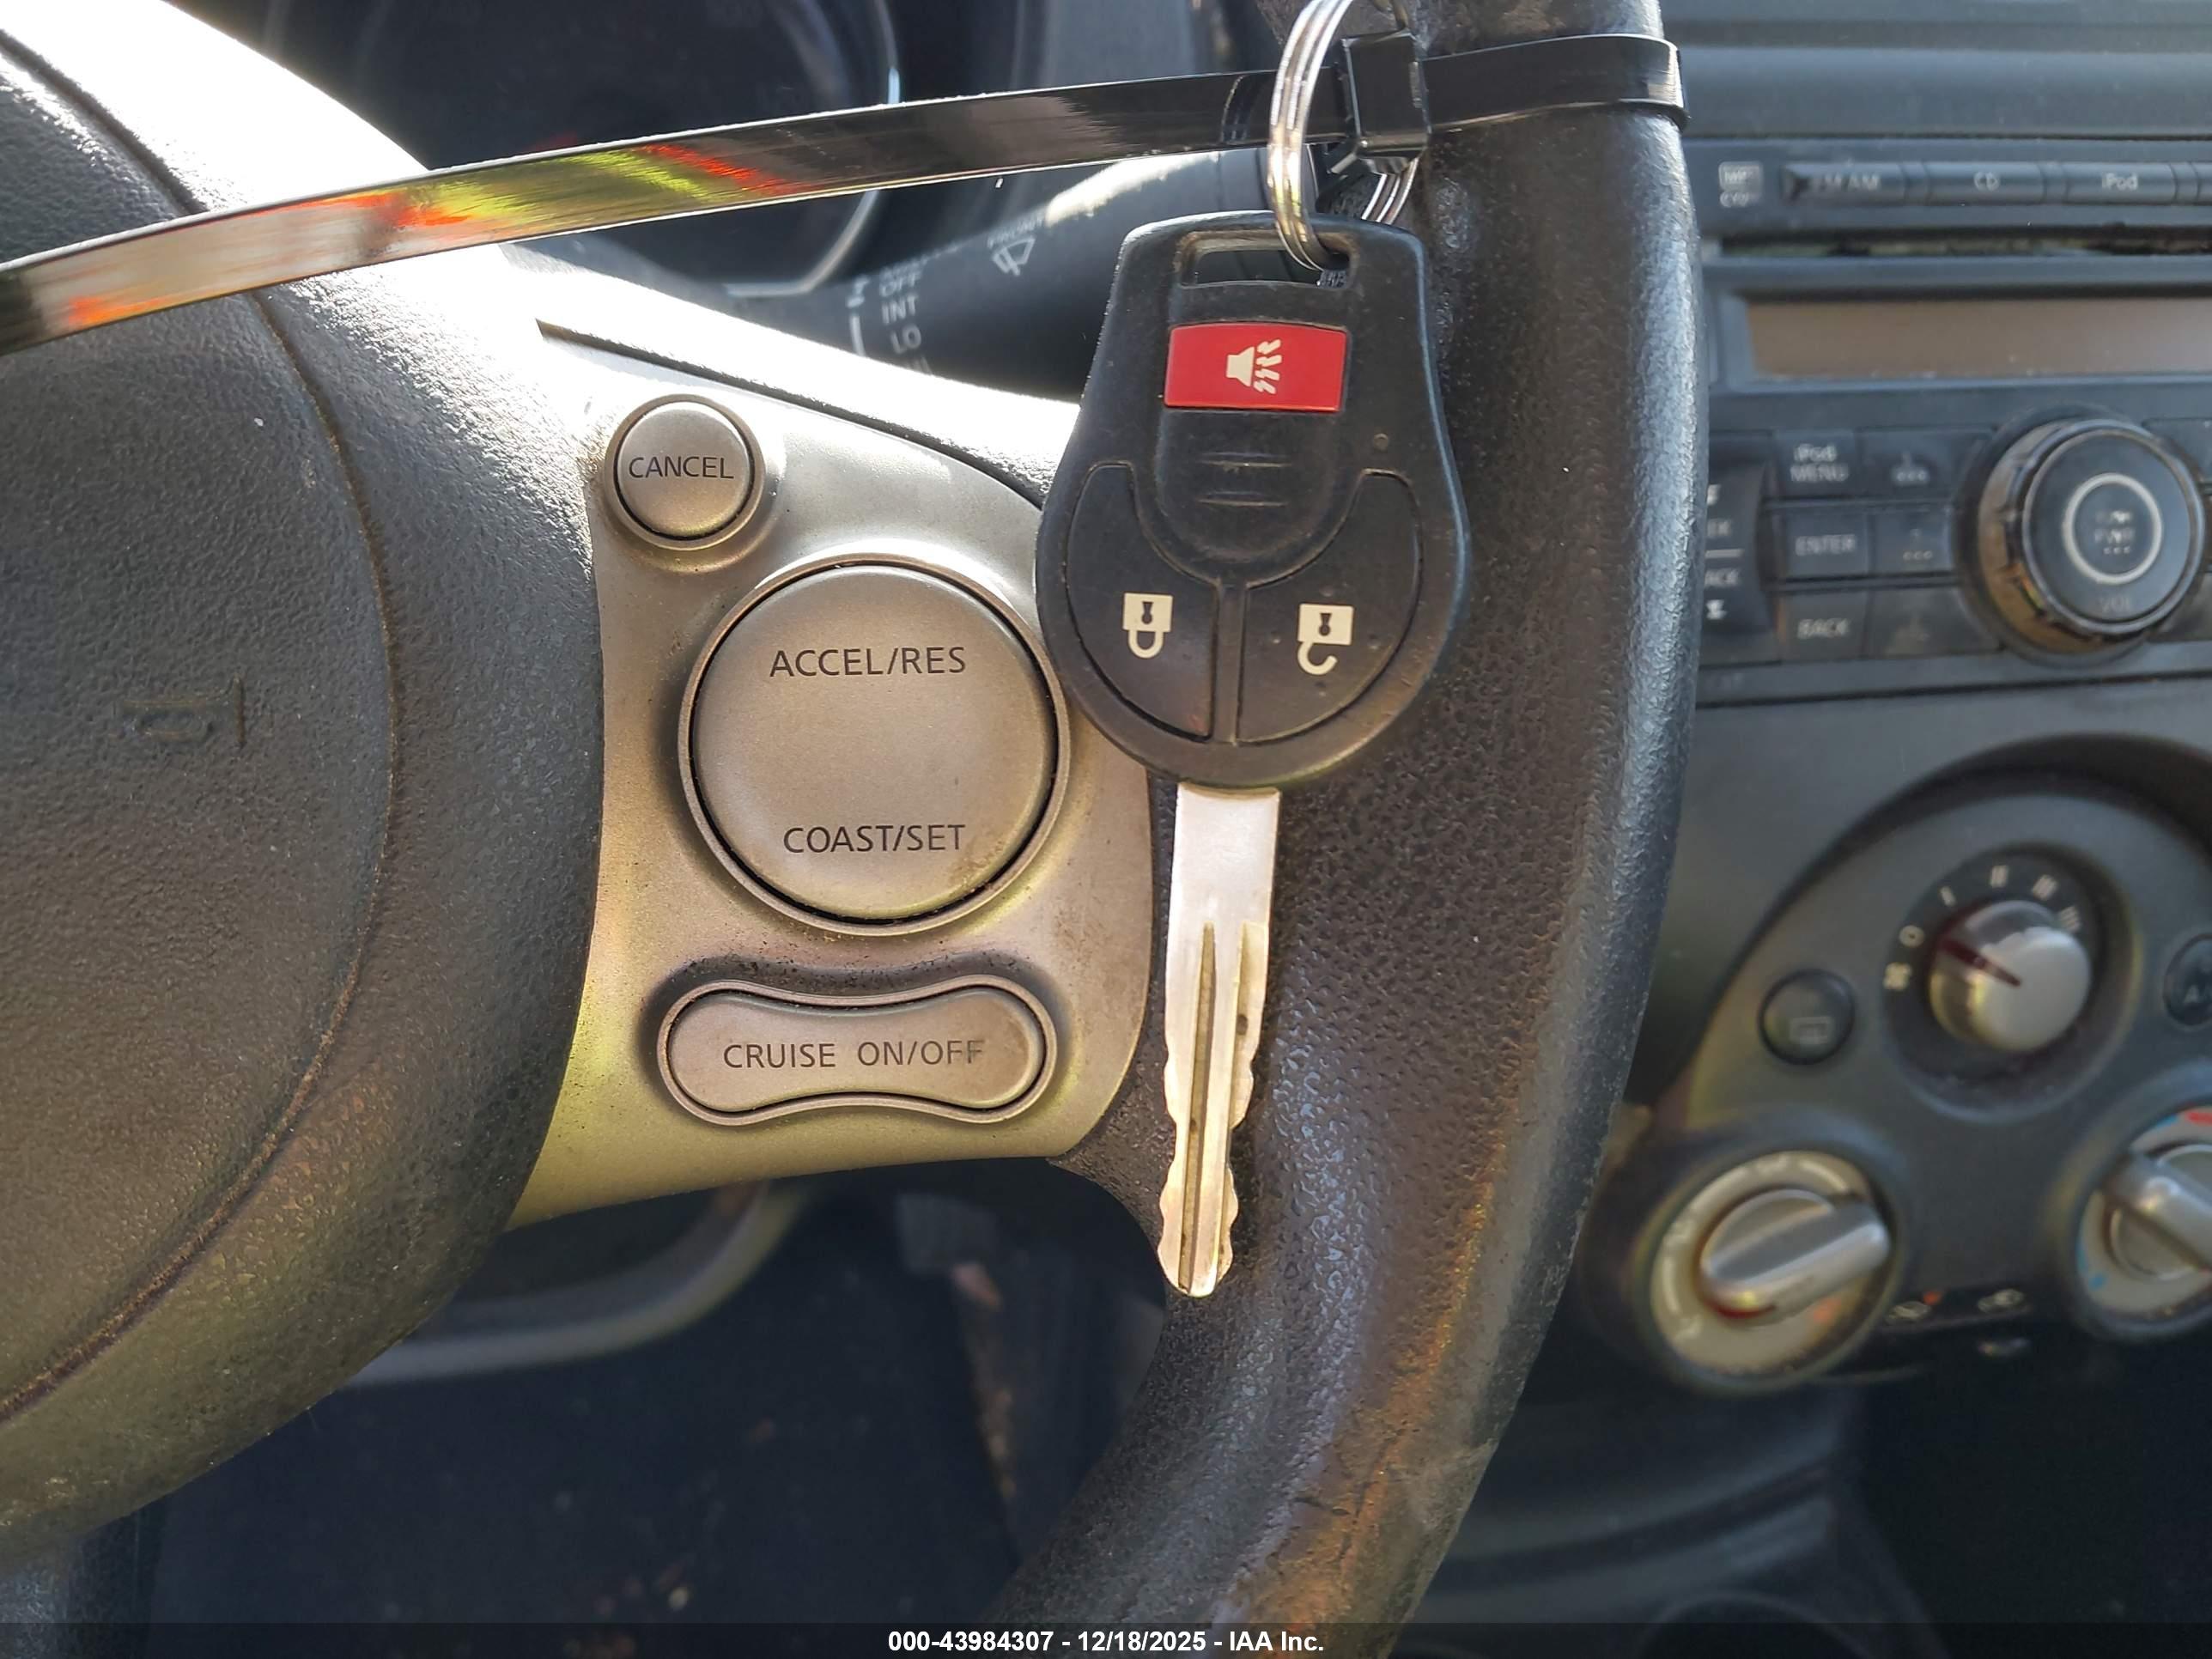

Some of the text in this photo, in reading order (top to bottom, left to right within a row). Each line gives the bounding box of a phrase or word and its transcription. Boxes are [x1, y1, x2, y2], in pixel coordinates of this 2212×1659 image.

[1974, 171, 2000, 191] CD
[2102, 171, 2138, 191] iPod
[882, 295, 917, 325] INT
[890, 324, 921, 354] LO
[1794, 442, 1838, 463] iPod
[629, 455, 735, 480] CANCEL
[1790, 463, 1849, 483] MENU
[1795, 534, 1856, 556] ENTER
[1797, 618, 1850, 640] BACK
[769, 647, 966, 678] ACCEL/RES
[782, 824, 966, 854] COAST/SET
[723, 1039, 984, 1069] CRUISE ON/OFF
